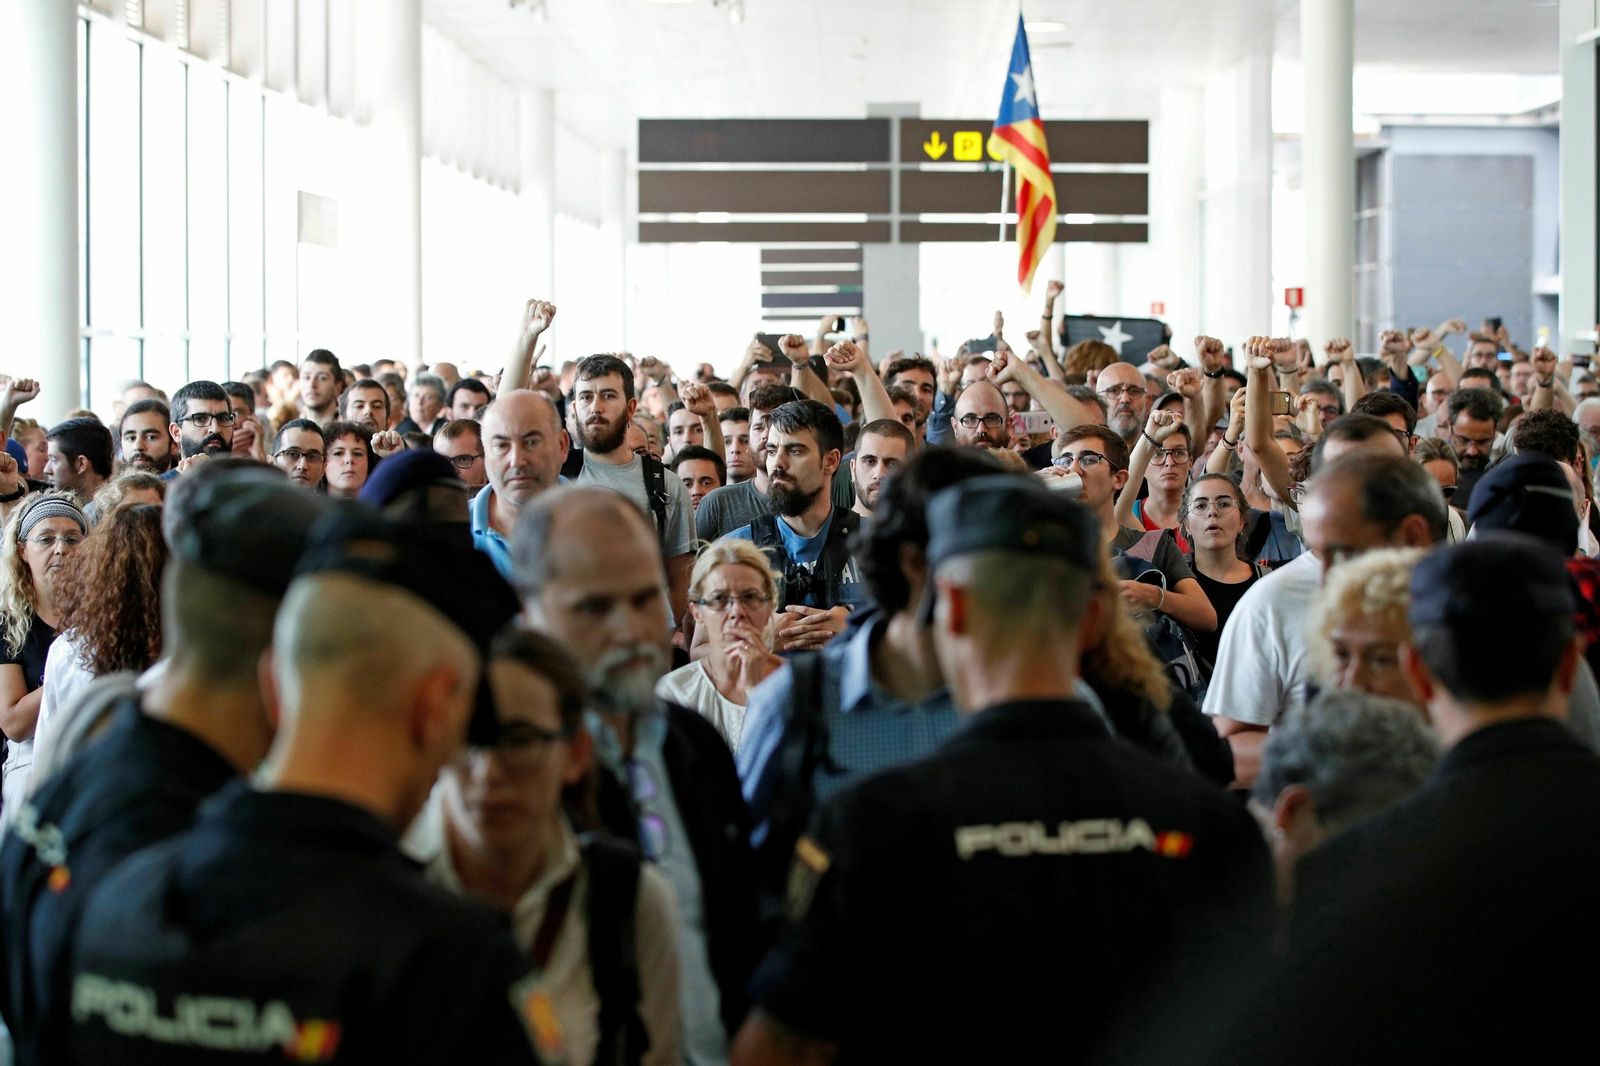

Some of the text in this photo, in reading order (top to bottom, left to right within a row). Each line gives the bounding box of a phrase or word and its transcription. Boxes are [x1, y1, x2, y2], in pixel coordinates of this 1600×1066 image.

[962, 138, 974, 153] P
[954, 817, 1156, 861] POLICIA
[71, 973, 298, 1053] POLICIA
